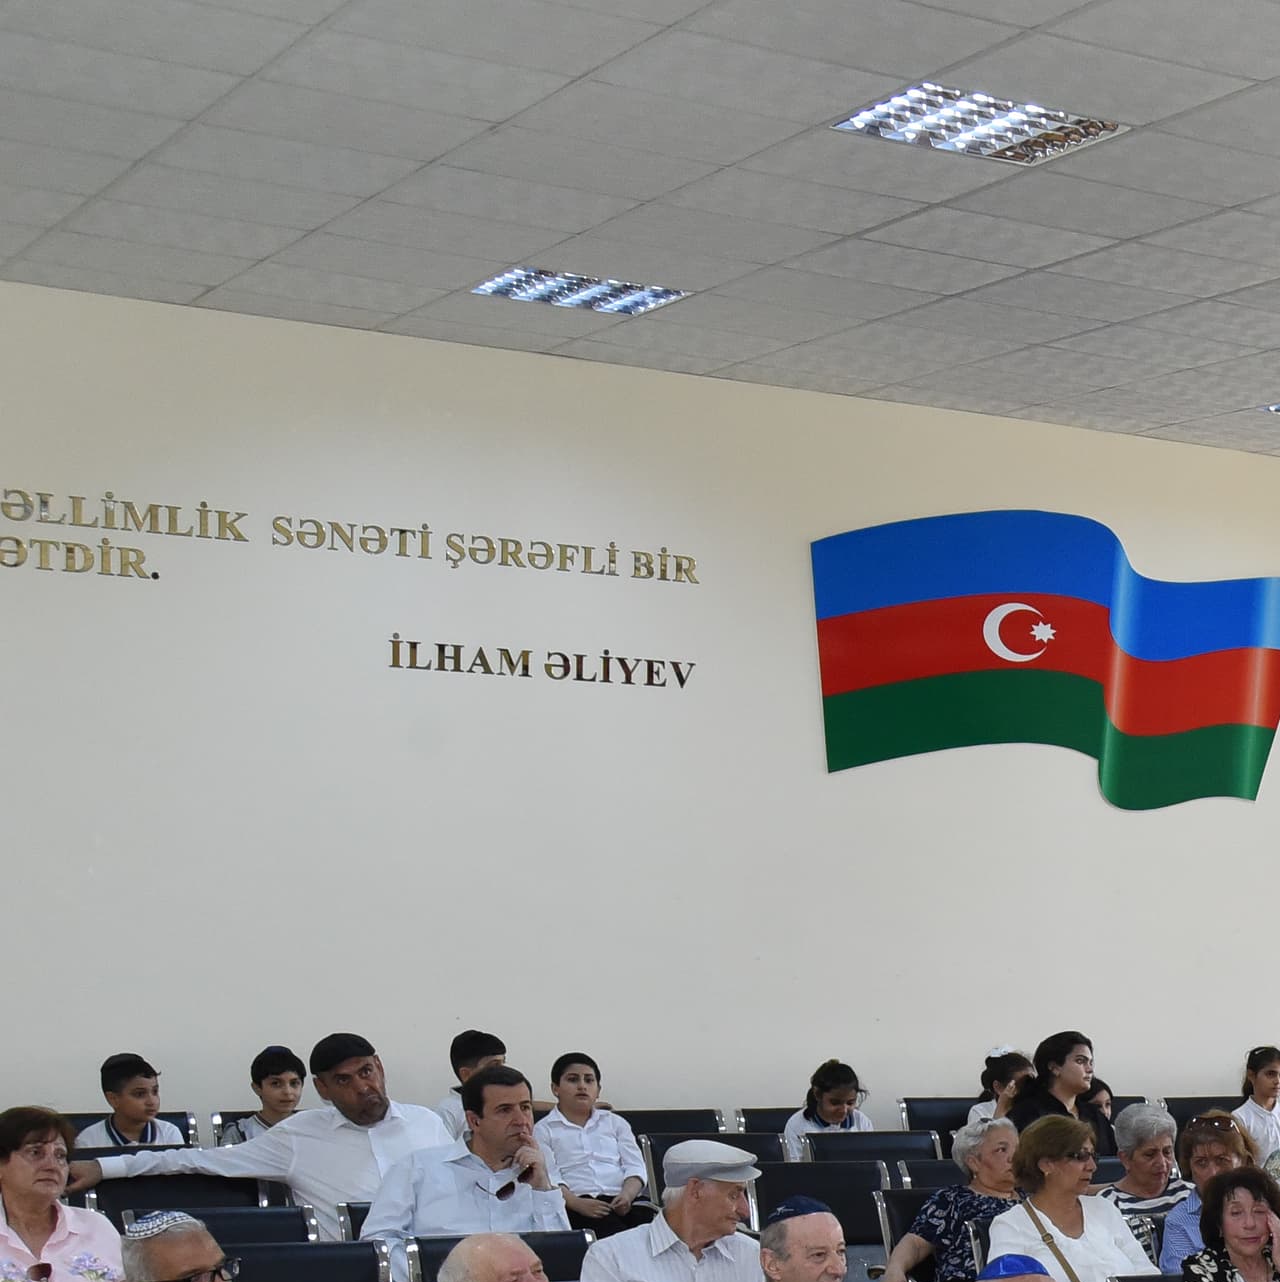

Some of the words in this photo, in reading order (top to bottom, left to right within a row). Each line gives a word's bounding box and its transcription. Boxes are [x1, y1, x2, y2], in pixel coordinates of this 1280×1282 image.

[271, 515, 433, 560] SƏNƏTİ
[445, 532, 620, 577] ŞƏRƏFLİ
[630, 546, 700, 584] BİR
[388, 632, 534, 678] İLHAM
[544, 649, 697, 689] ƏLİYEV
